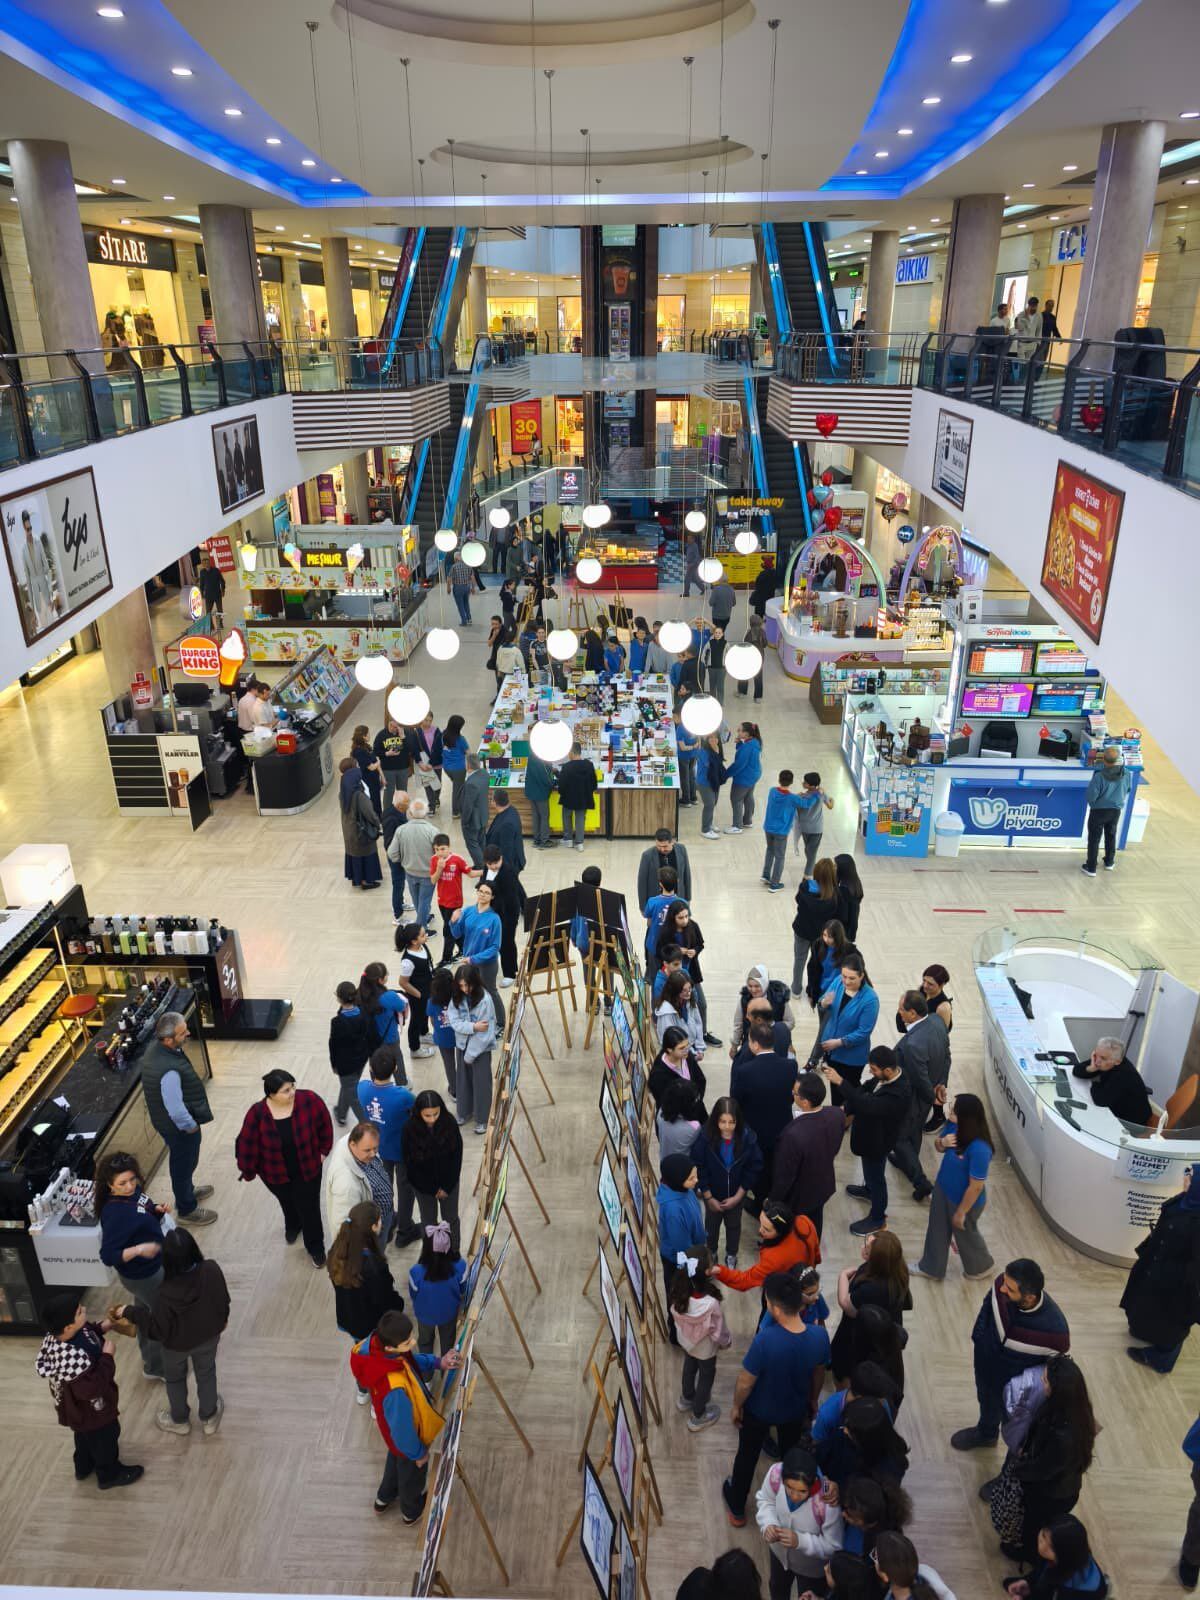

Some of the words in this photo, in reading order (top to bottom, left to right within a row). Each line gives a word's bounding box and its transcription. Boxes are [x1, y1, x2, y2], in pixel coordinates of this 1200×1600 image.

[99, 230, 148, 264] SİTARE
[514, 418, 538, 434] 30
[729, 496, 753, 507] take
[756, 497, 784, 508] away
[739, 507, 770, 516] coffee
[306, 552, 342, 568] MEŞHUR
[181, 649, 217, 658] BURGER
[182, 657, 219, 669] KING
[1007, 805, 1037, 816] milli
[1005, 816, 1060, 829] piyango
